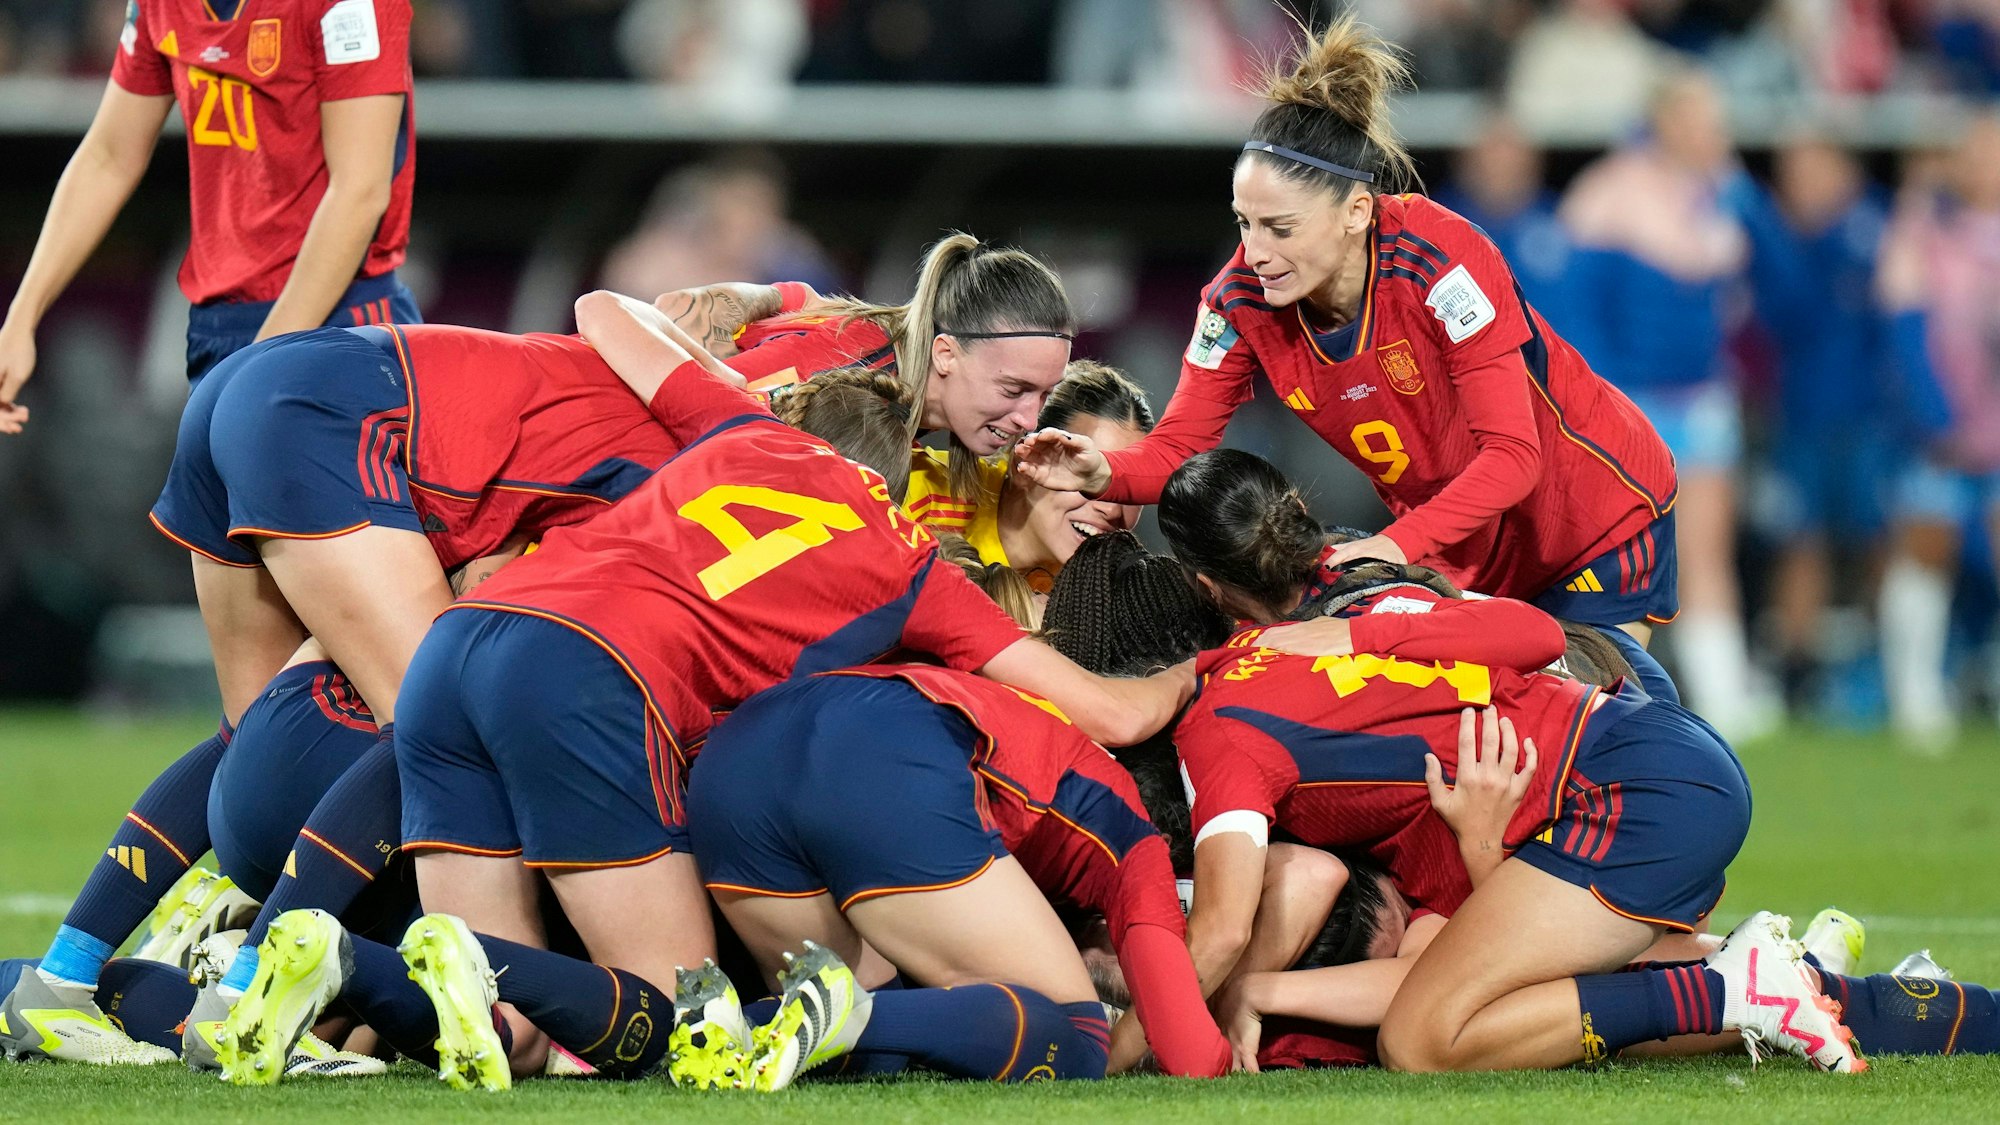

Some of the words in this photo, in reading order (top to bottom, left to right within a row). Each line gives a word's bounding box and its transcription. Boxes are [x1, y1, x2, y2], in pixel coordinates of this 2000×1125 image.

[188, 65, 259, 152] 20
[1437, 281, 1463, 306] FOOTBALL
[1441, 288, 1470, 313] UNITES
[1350, 420, 1410, 484] 9
[677, 485, 867, 601] 4
